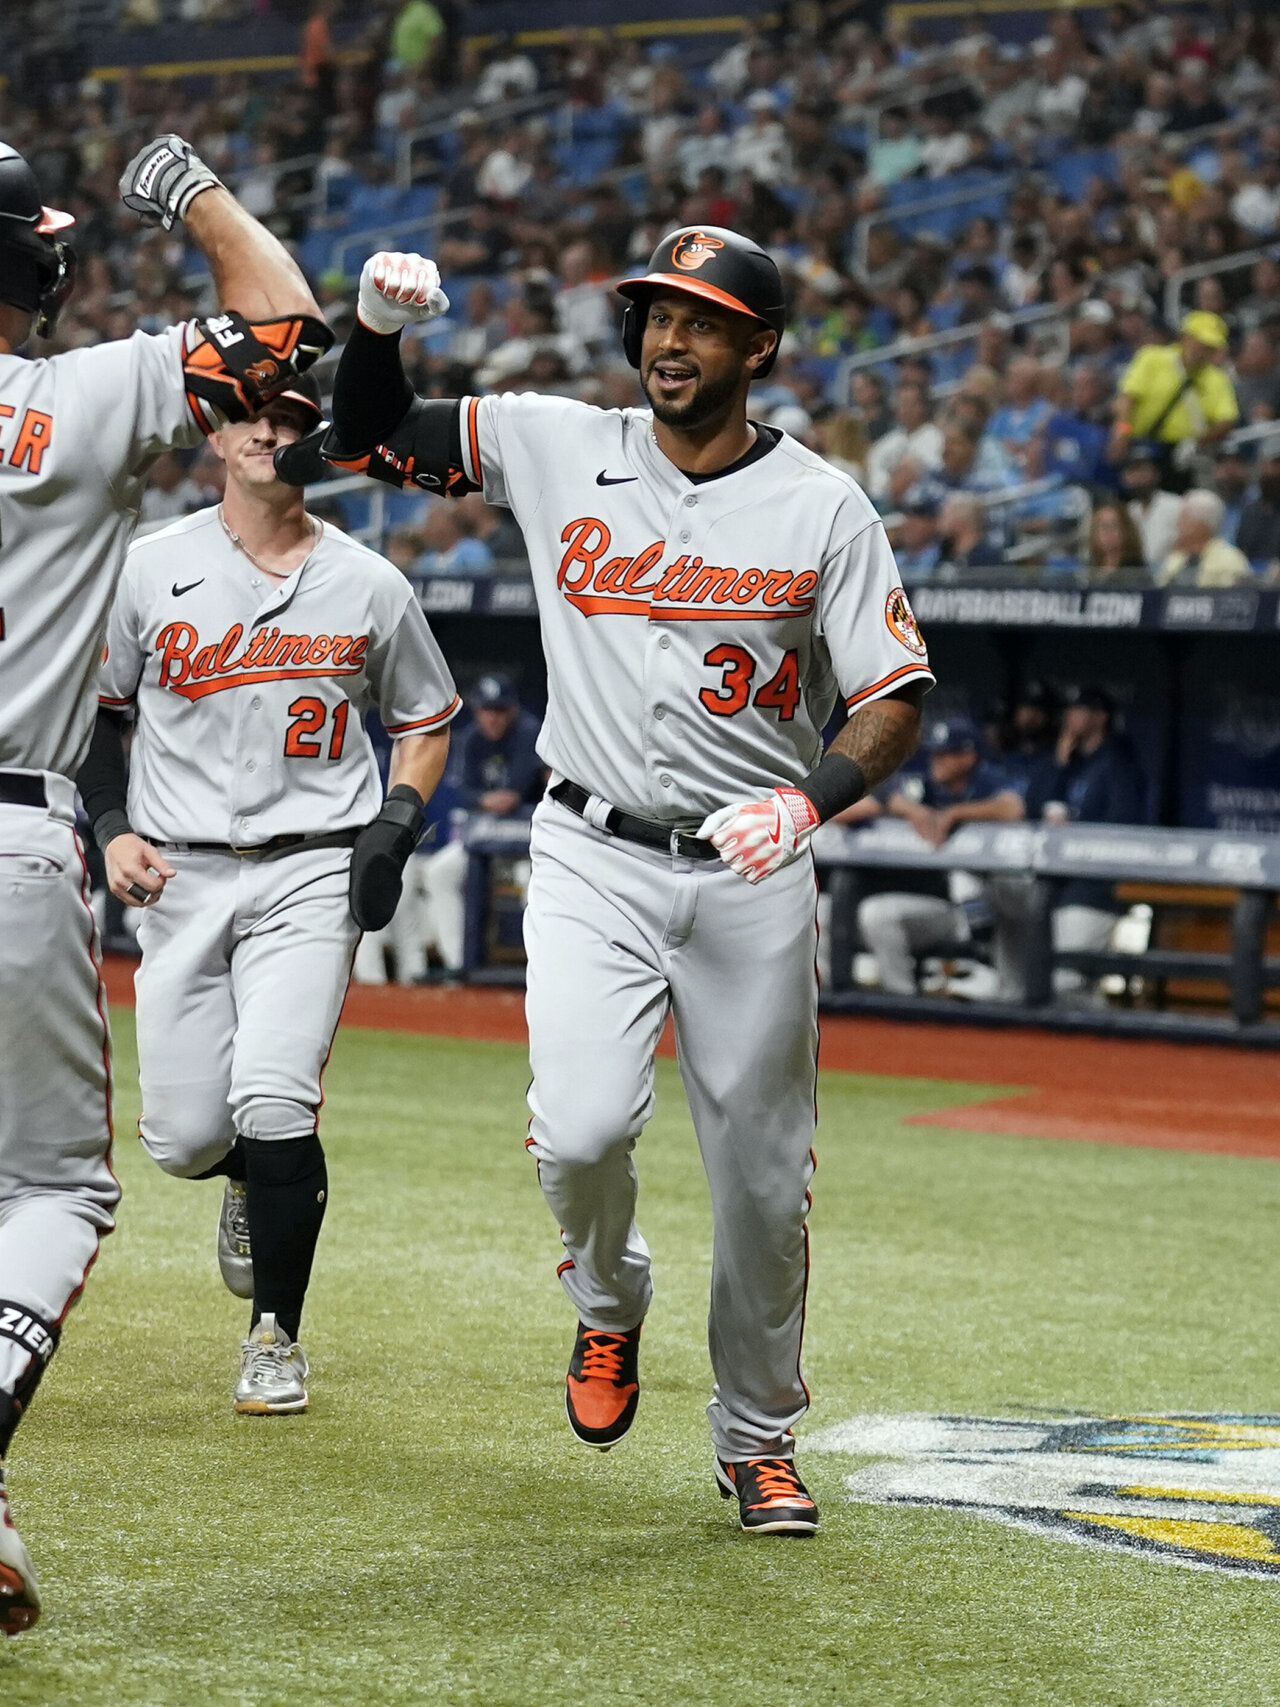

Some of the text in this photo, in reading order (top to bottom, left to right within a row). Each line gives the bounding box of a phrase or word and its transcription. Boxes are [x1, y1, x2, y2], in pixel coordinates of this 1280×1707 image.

[557, 517, 819, 608] Baltimore
[155, 621, 370, 688] Baltimore
[698, 642, 802, 722] 34
[283, 696, 350, 760] 21
